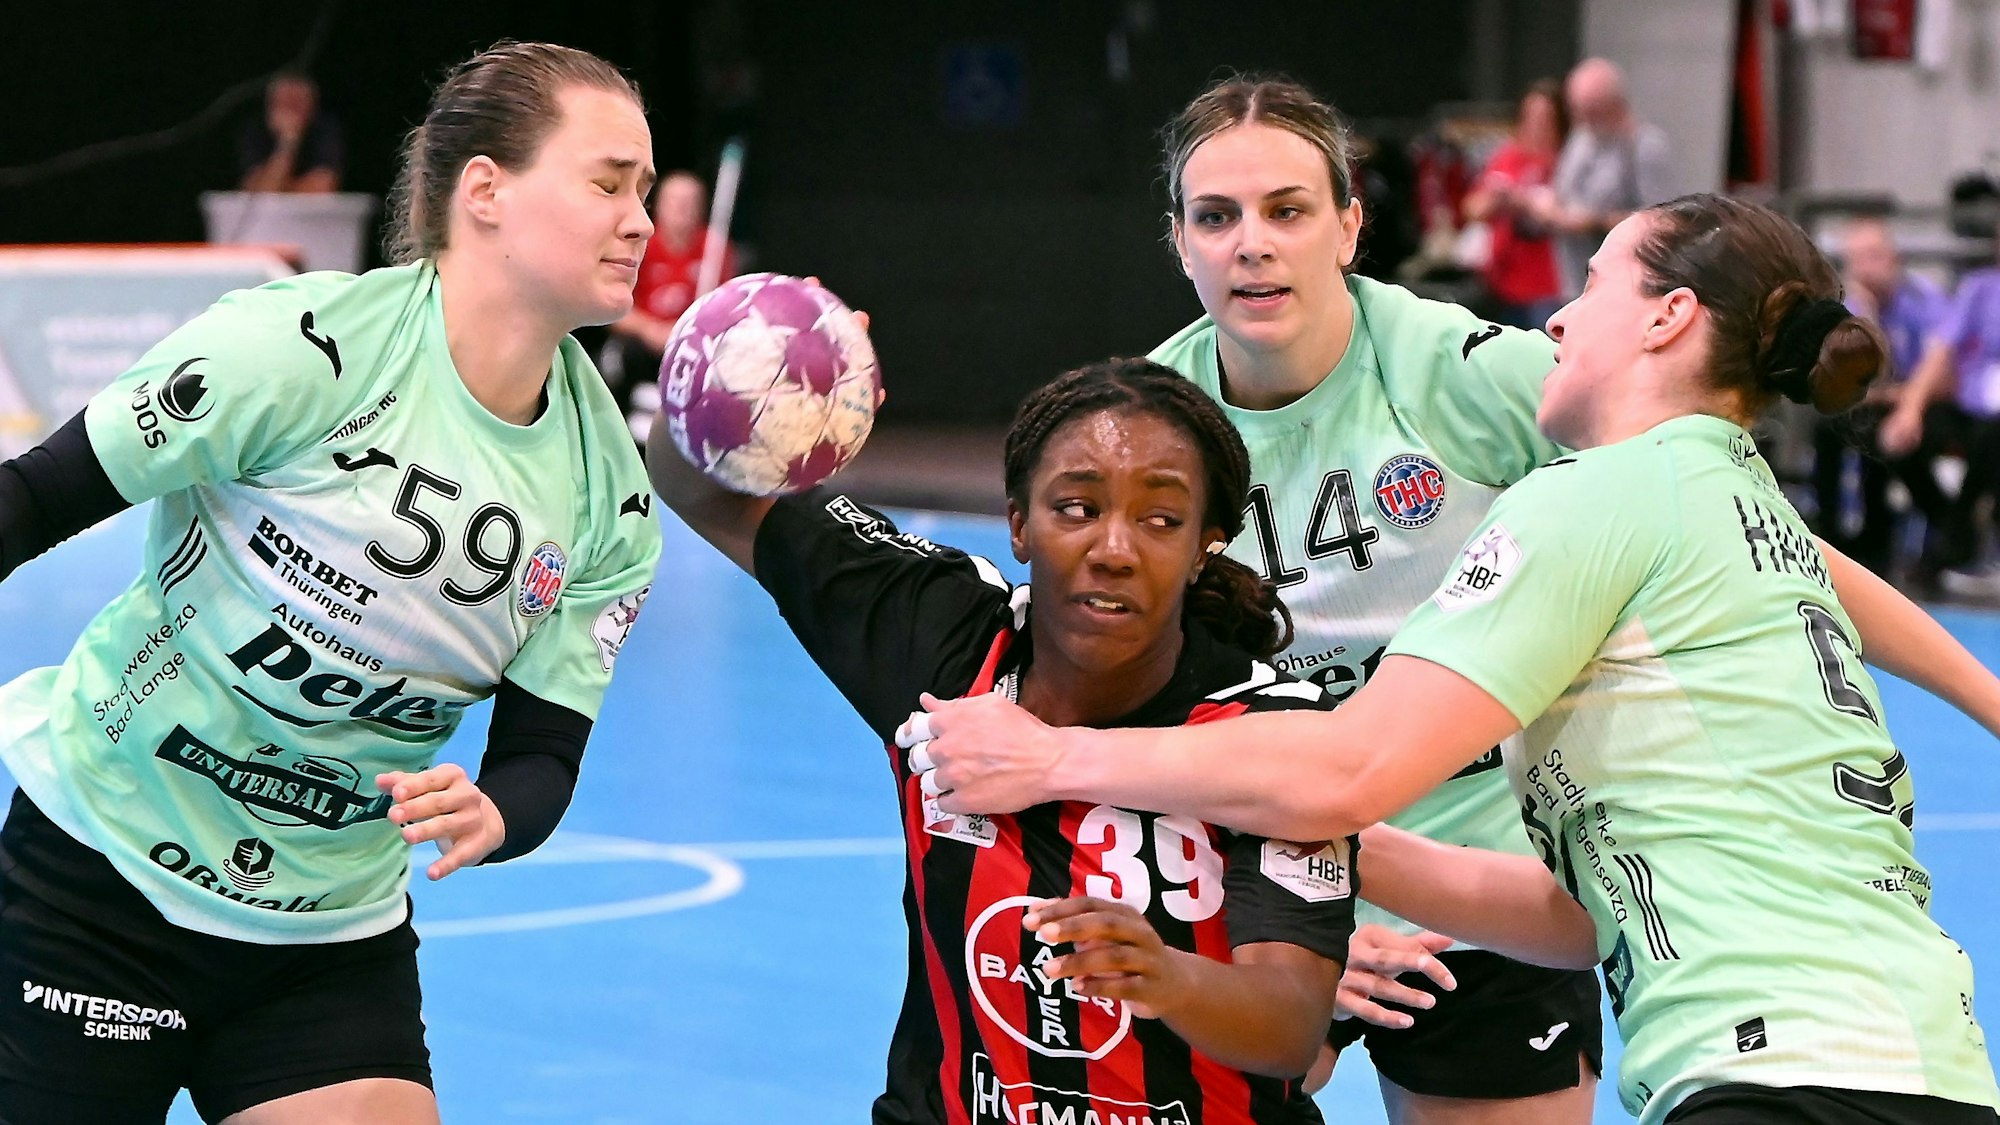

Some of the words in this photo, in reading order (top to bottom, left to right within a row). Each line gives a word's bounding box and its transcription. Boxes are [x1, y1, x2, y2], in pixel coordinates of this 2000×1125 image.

[131, 381, 167, 449] MOOS
[1377, 469, 1444, 515] THC
[364, 463, 524, 607] 59
[832, 500, 936, 551] HOFMNN
[1241, 469, 1379, 590] 14
[256, 515, 378, 606] BORBET
[525, 556, 561, 606] THC
[1458, 564, 1502, 591] HBF
[279, 562, 363, 626] Thüringen
[271, 602, 384, 673] Autohaus
[1277, 646, 1346, 672] ohaus
[225, 622, 473, 719] pete
[106, 701, 133, 744] Bad
[179, 743, 332, 818] UNIVERSAL
[1527, 765, 1559, 811] Bad
[1077, 805, 1225, 922] 39
[1308, 856, 1345, 885] HBF
[84, 1021, 152, 1041] SCHENK
